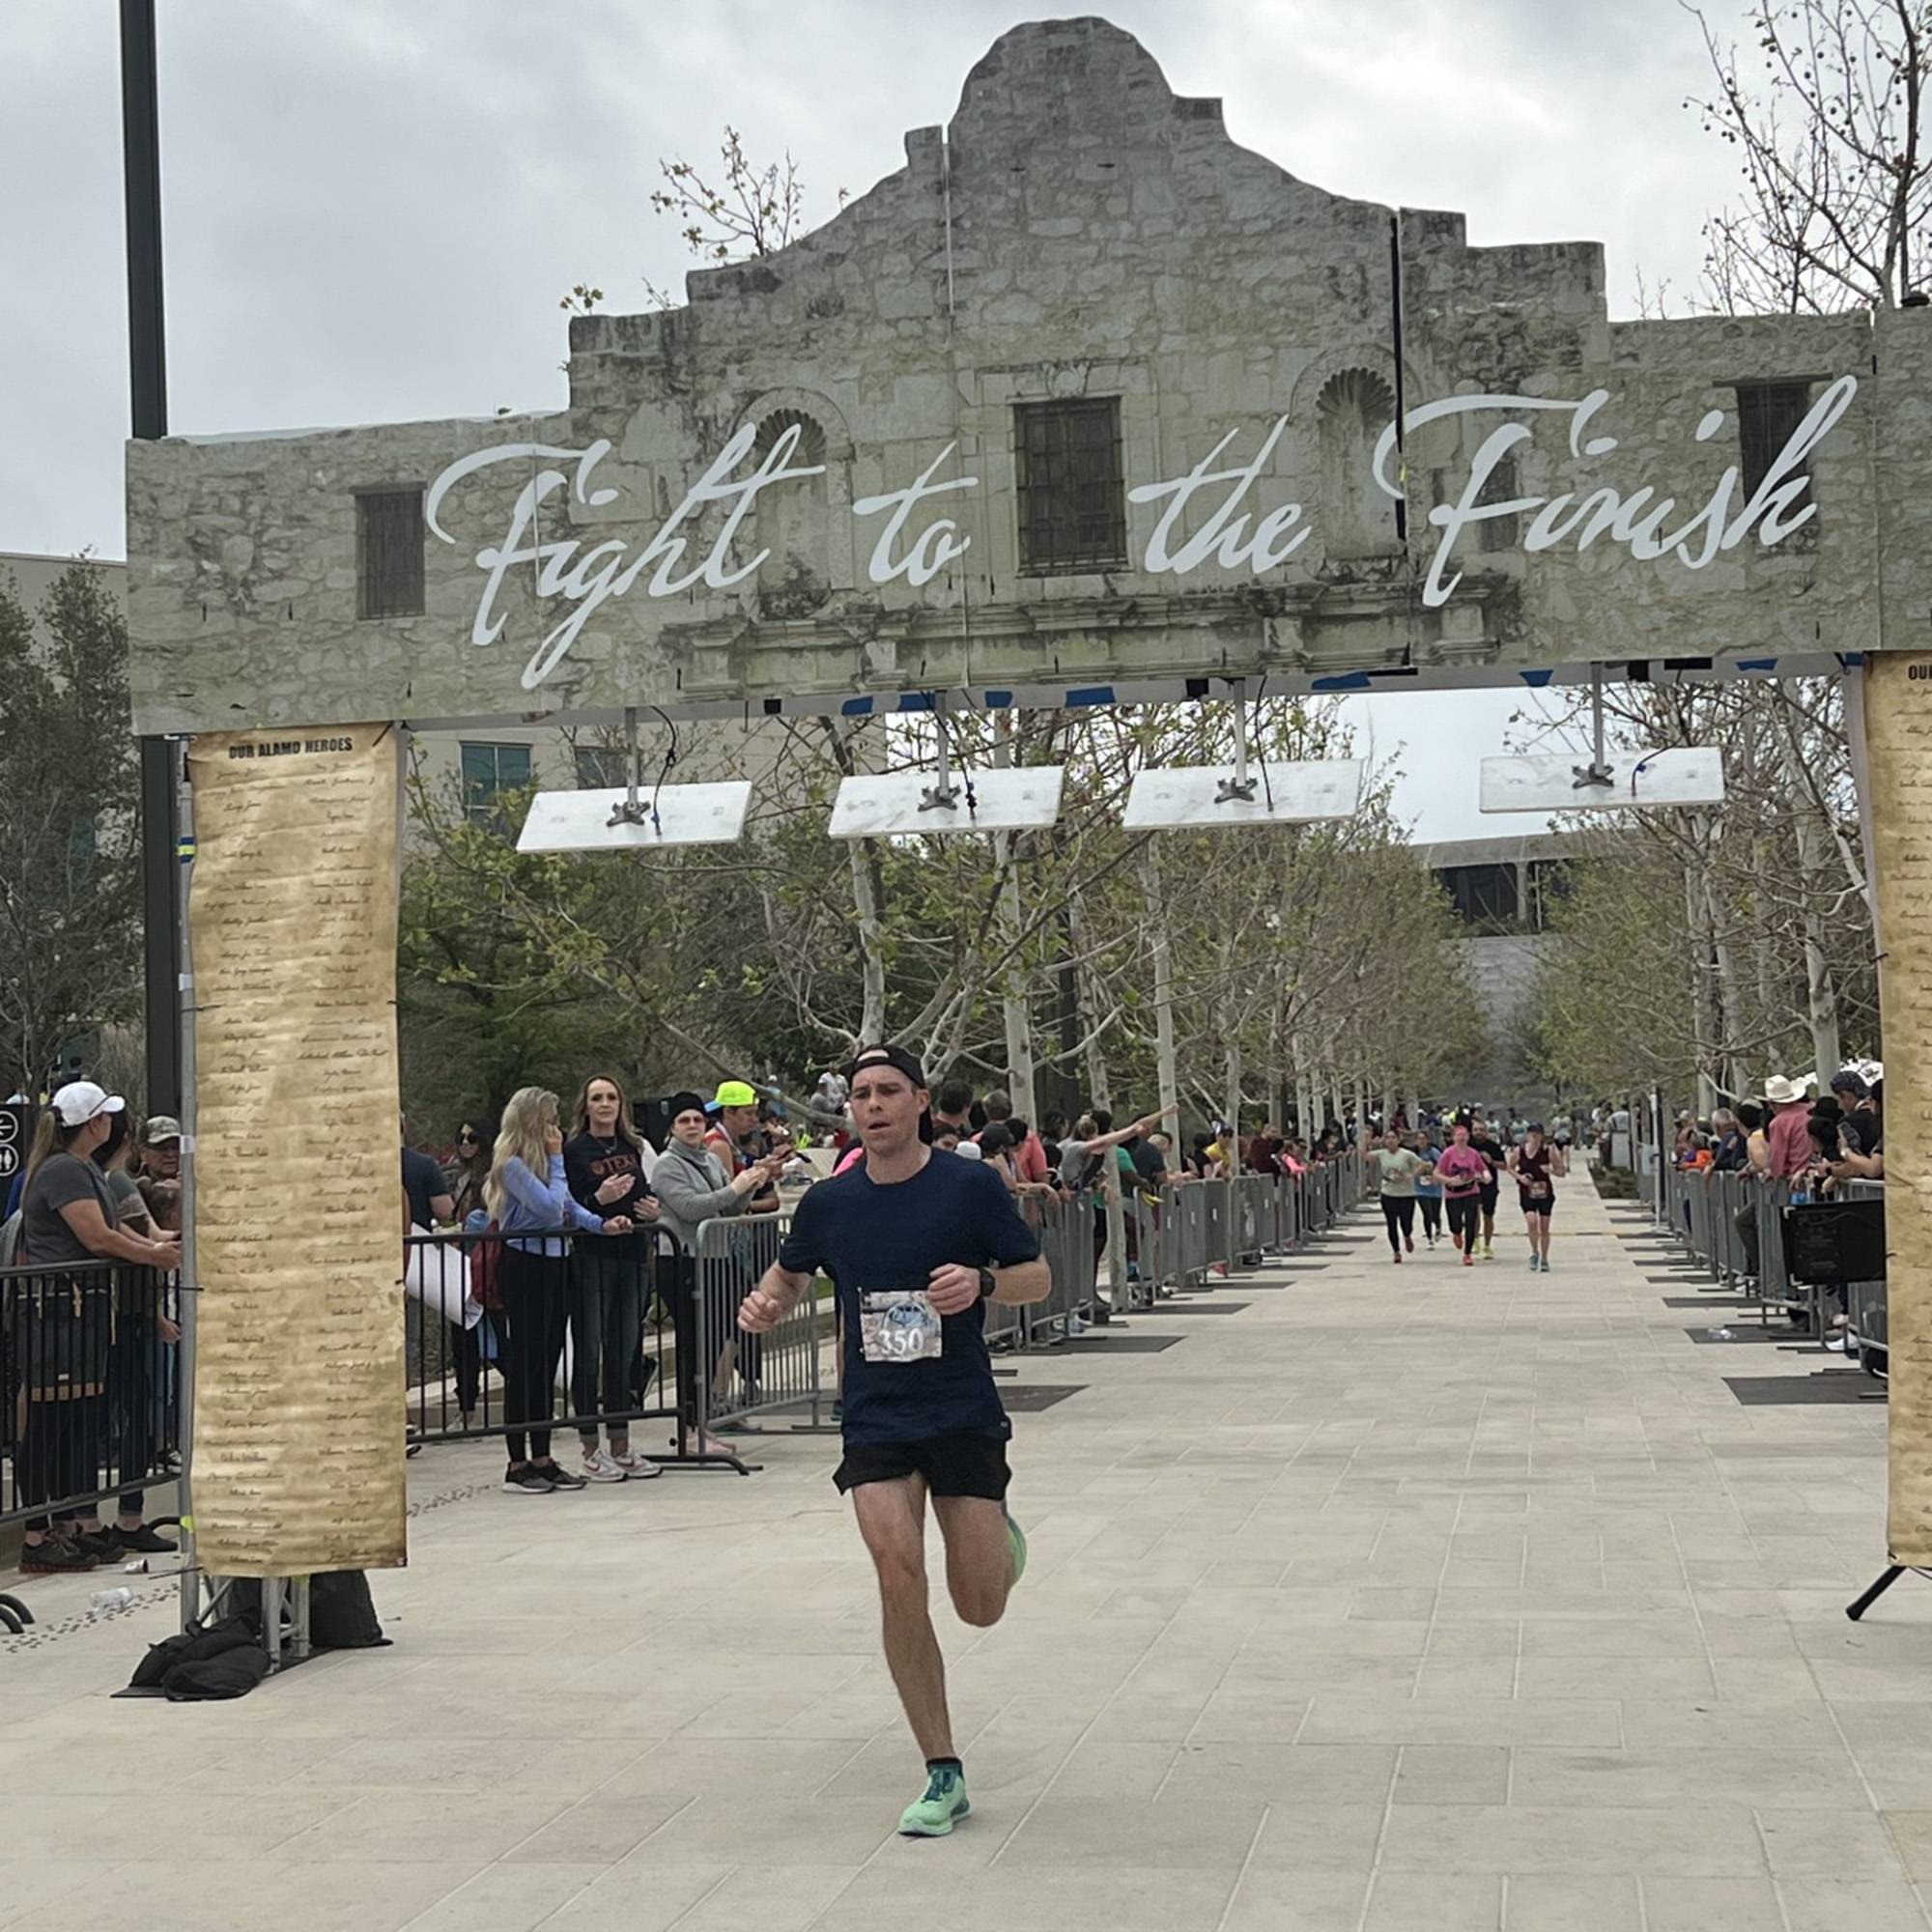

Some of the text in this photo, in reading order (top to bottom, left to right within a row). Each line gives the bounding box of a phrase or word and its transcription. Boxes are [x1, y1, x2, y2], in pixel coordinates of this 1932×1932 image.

[425, 375, 1858, 688] Fight to the Finish
[229, 737, 353, 759] OUR ALAMO HEROES
[878, 1327, 924, 1354] 350
